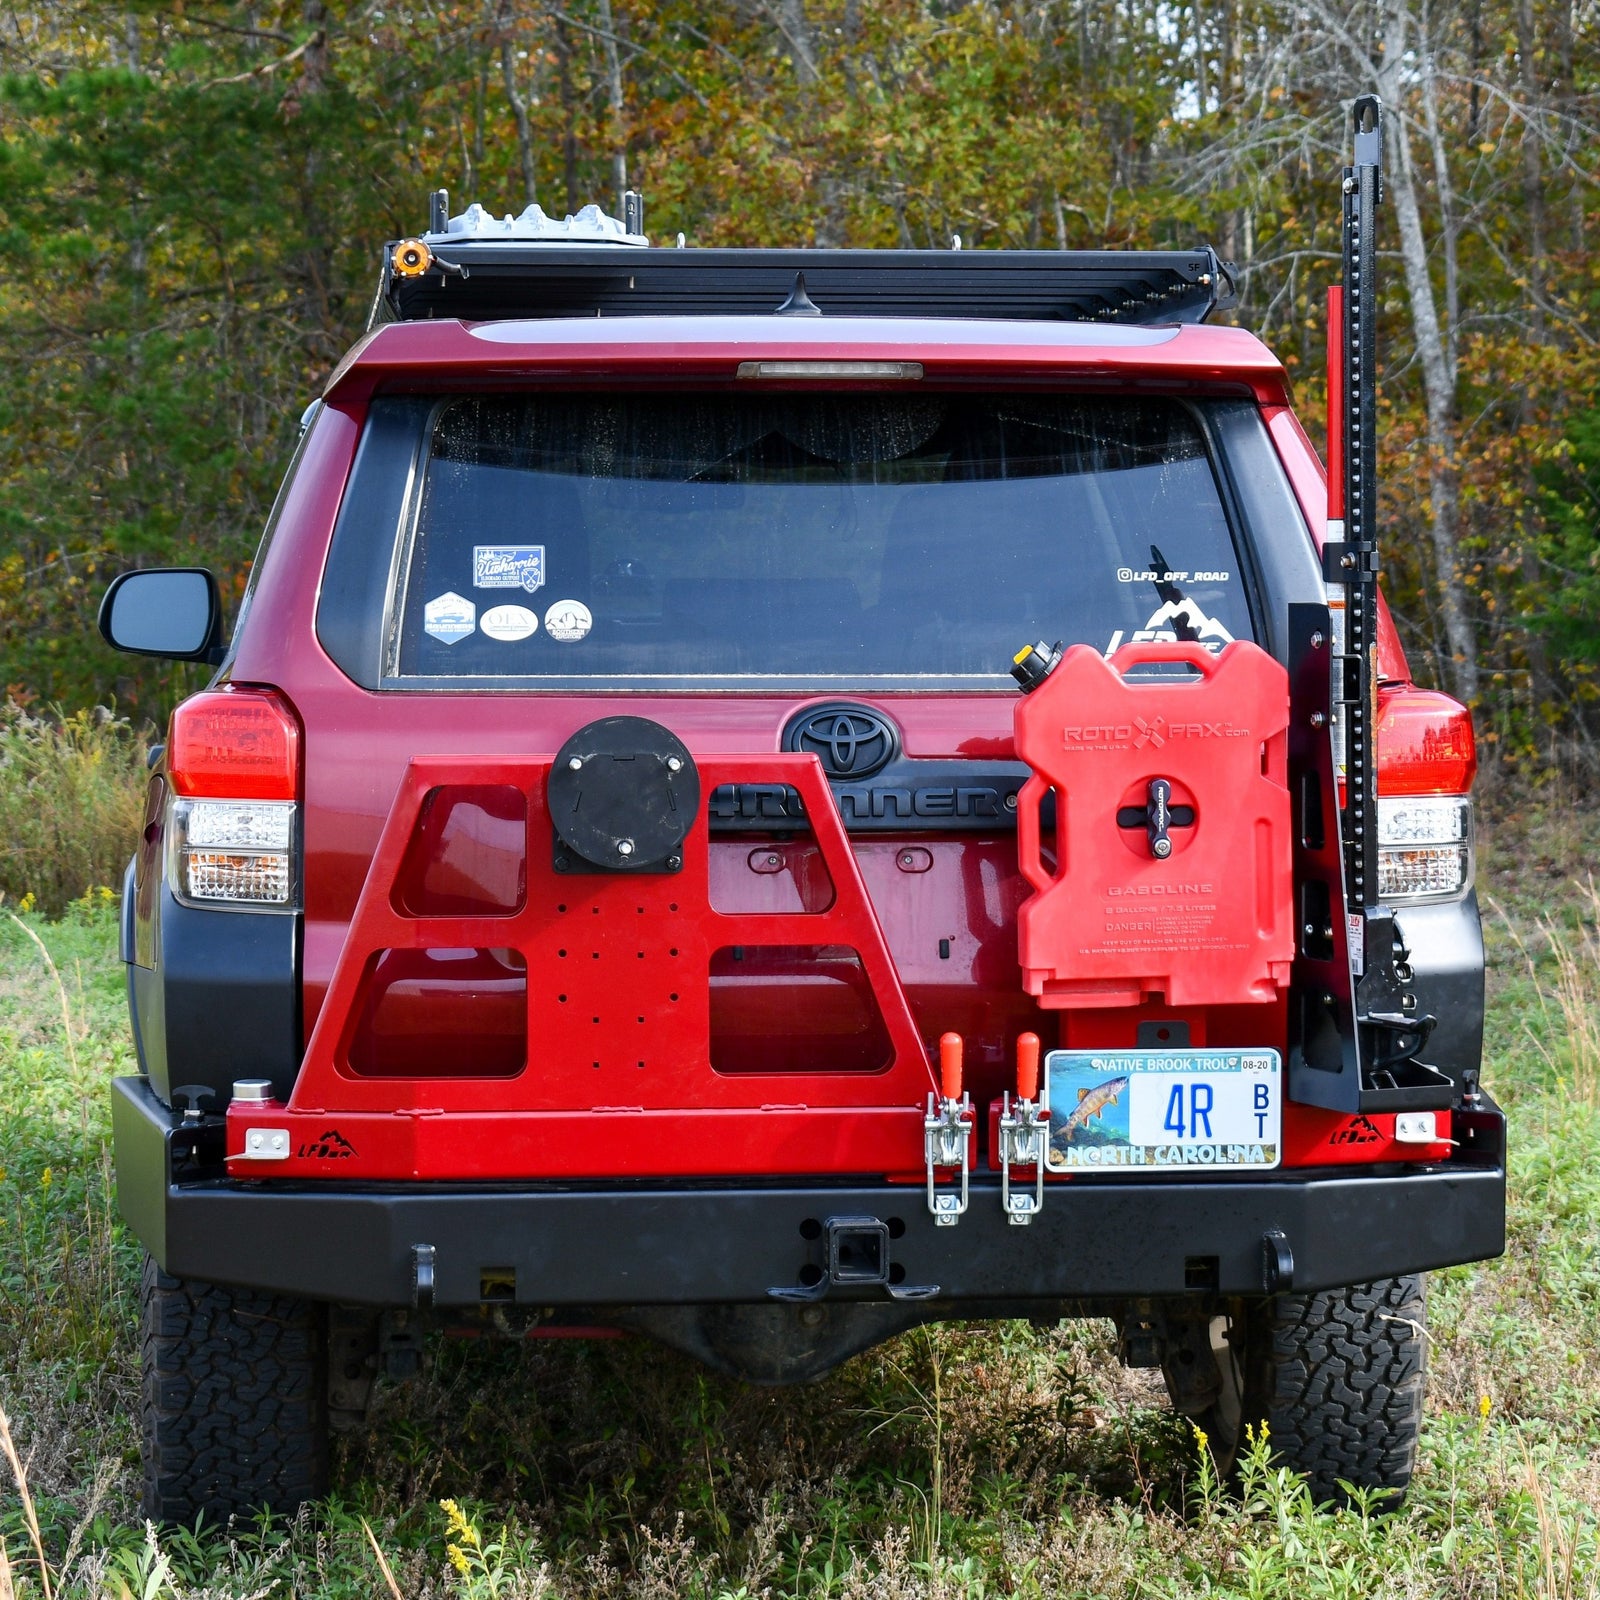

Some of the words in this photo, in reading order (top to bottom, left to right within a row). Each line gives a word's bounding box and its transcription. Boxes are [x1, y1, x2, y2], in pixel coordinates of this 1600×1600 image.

[1188, 263, 1200, 272] SF
[1133, 571, 1230, 583] LFD_OFF_ROAD
[1064, 725, 1132, 741] ROTO
[1107, 883, 1213, 897] GASOLINE
[1115, 905, 1158, 914] GALLONS
[1185, 904, 1217, 912] LITERS
[1105, 921, 1152, 932] DANGER
[1097, 1058, 1144, 1072] NATIVE
[1147, 1058, 1193, 1071] BROOK
[1194, 1057, 1237, 1071] TROU
[1242, 1060, 1268, 1070] 08-20
[1163, 1083, 1214, 1139] 4R
[1067, 1145, 1147, 1166] NORTH
[1154, 1144, 1265, 1164] CAROLINA
